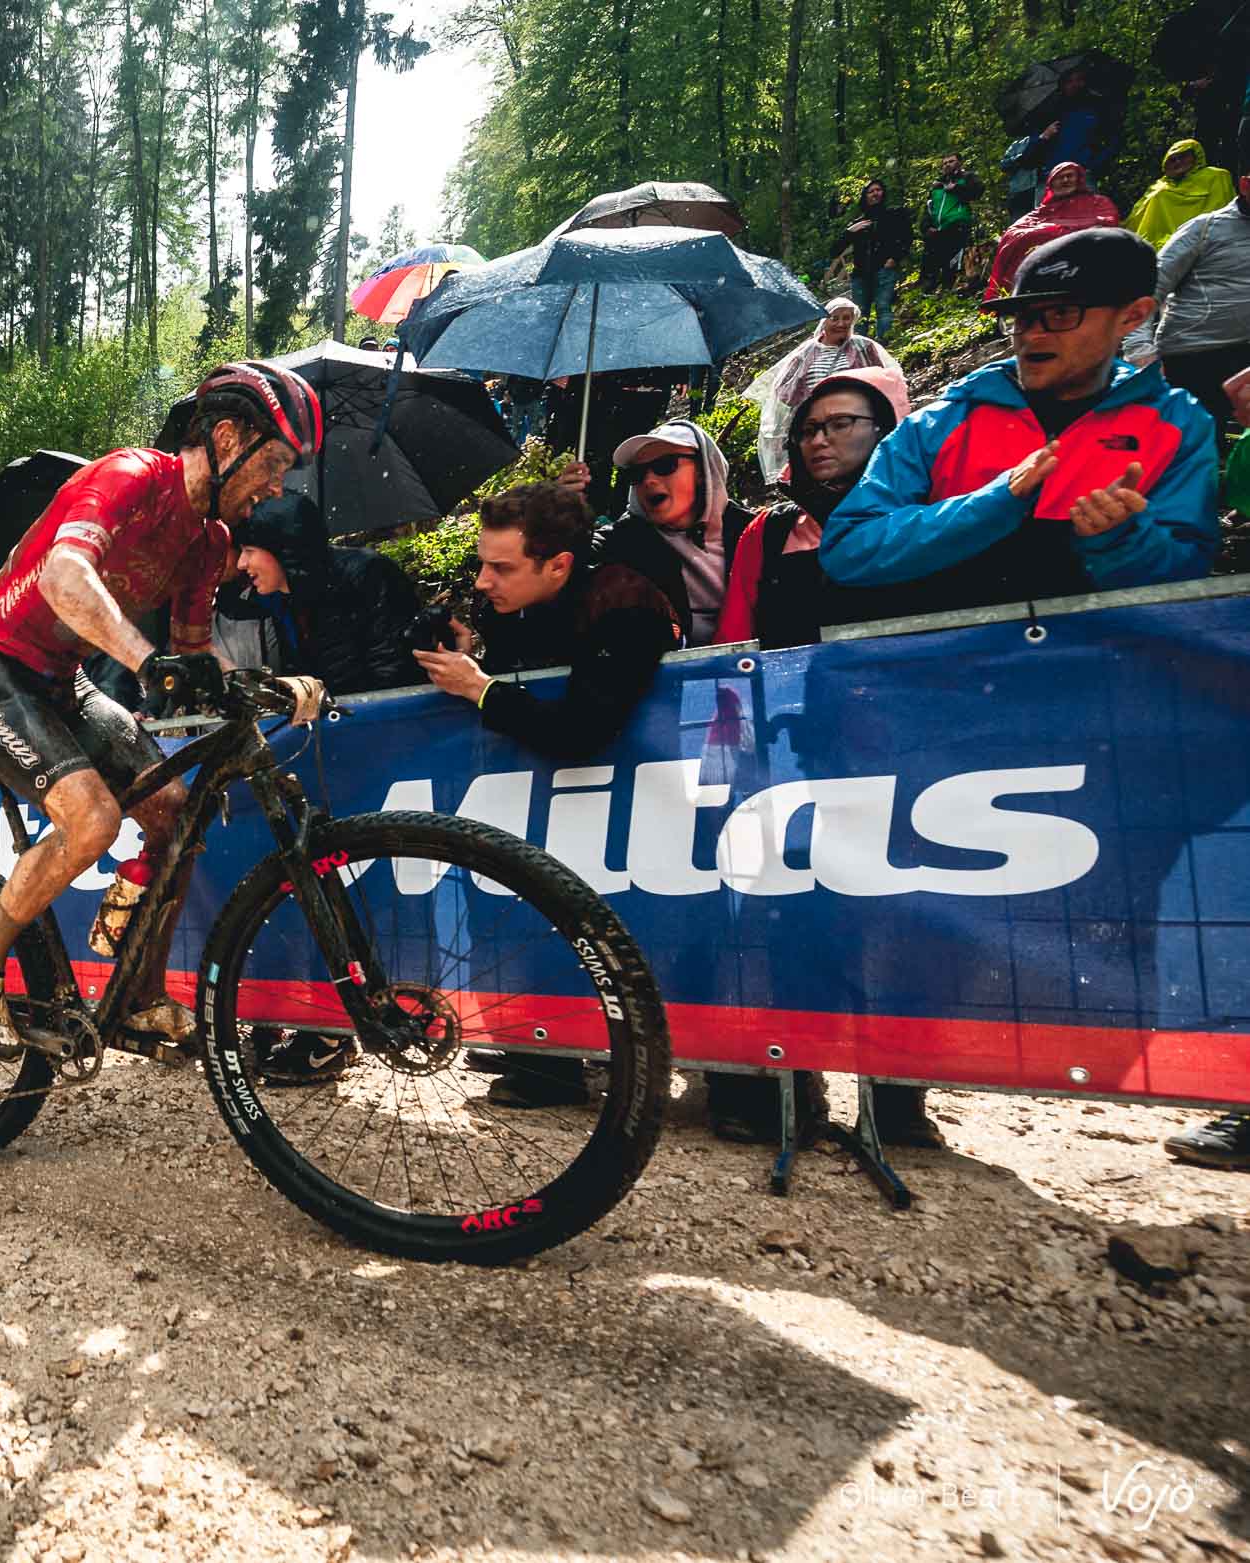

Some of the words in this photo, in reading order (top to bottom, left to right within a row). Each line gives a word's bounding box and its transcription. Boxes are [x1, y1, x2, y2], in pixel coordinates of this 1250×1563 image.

[336, 758, 1099, 896] Mitas
[571, 937, 612, 987] SWISS
[600, 991, 624, 1021] DT
[204, 986, 251, 1136] SCHWALBE
[224, 1050, 242, 1075] DT
[232, 1077, 263, 1122] SWISS
